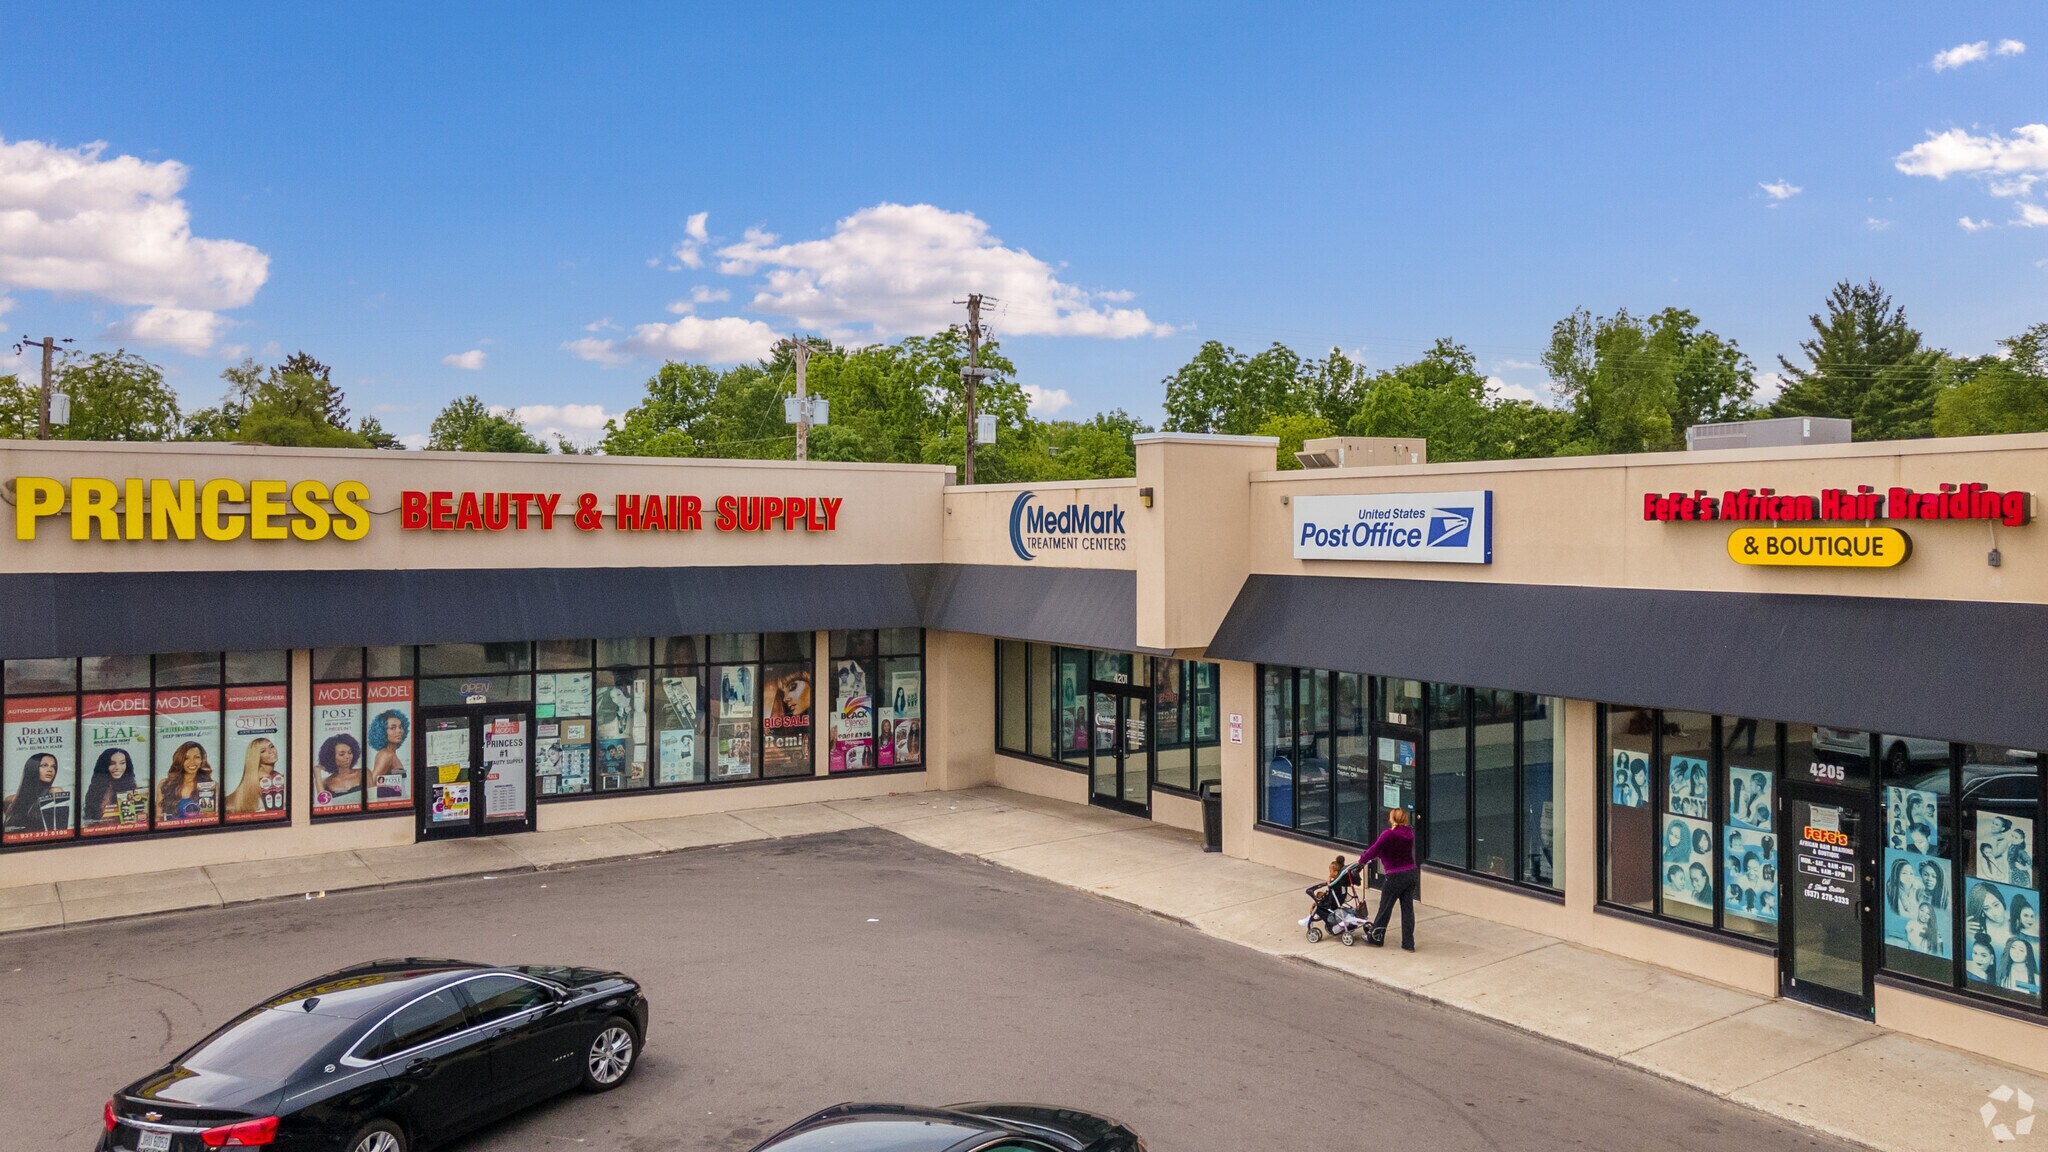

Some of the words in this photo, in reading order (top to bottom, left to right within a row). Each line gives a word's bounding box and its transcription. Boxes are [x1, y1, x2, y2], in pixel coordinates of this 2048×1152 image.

[16, 476, 370, 541] PRINCESS
[401, 491, 561, 531] BEAUTY
[573, 493, 603, 531] &
[615, 494, 702, 531] HAIR
[715, 495, 843, 532] SUPPLY
[1644, 490, 1714, 521] FeFe's
[1720, 488, 1817, 521] African
[1820, 485, 1880, 521] Hair
[1888, 483, 2030, 527] Braiding
[1027, 504, 1126, 534] MedMark
[1358, 508, 1391, 520] United
[1392, 508, 1426, 519] States
[1300, 522, 1350, 548] Post
[1351, 521, 1422, 548] Office
[1027, 537, 1078, 549] TREATMENT
[1082, 538, 1127, 551] CENTERS
[1743, 536, 1760, 556] &
[1766, 536, 1884, 557] BOUTIQUE
[1114, 674, 1128, 684] 4201
[319, 688, 362, 700] MODEL
[368, 685, 409, 698] MODEL
[461, 683, 489, 694] OPEN
[98, 698, 148, 712] MODEL
[156, 695, 203, 709] MODEL
[322, 708, 354, 719] POSE
[841, 711, 867, 720] BLACK
[235, 717, 277, 730] QUTIX
[764, 717, 782, 728] BIG
[783, 715, 809, 728] SALE
[22, 727, 58, 735] DREAM
[93, 727, 136, 740] LEAF
[17, 736, 63, 745] WEAVER
[486, 739, 524, 748] PRINCESS
[765, 733, 803, 747] Remi
[499, 749, 508, 758] #1
[1810, 762, 1845, 780] 4205
[321, 792, 329, 804] 3
[1804, 826, 1848, 846] FeFe's
